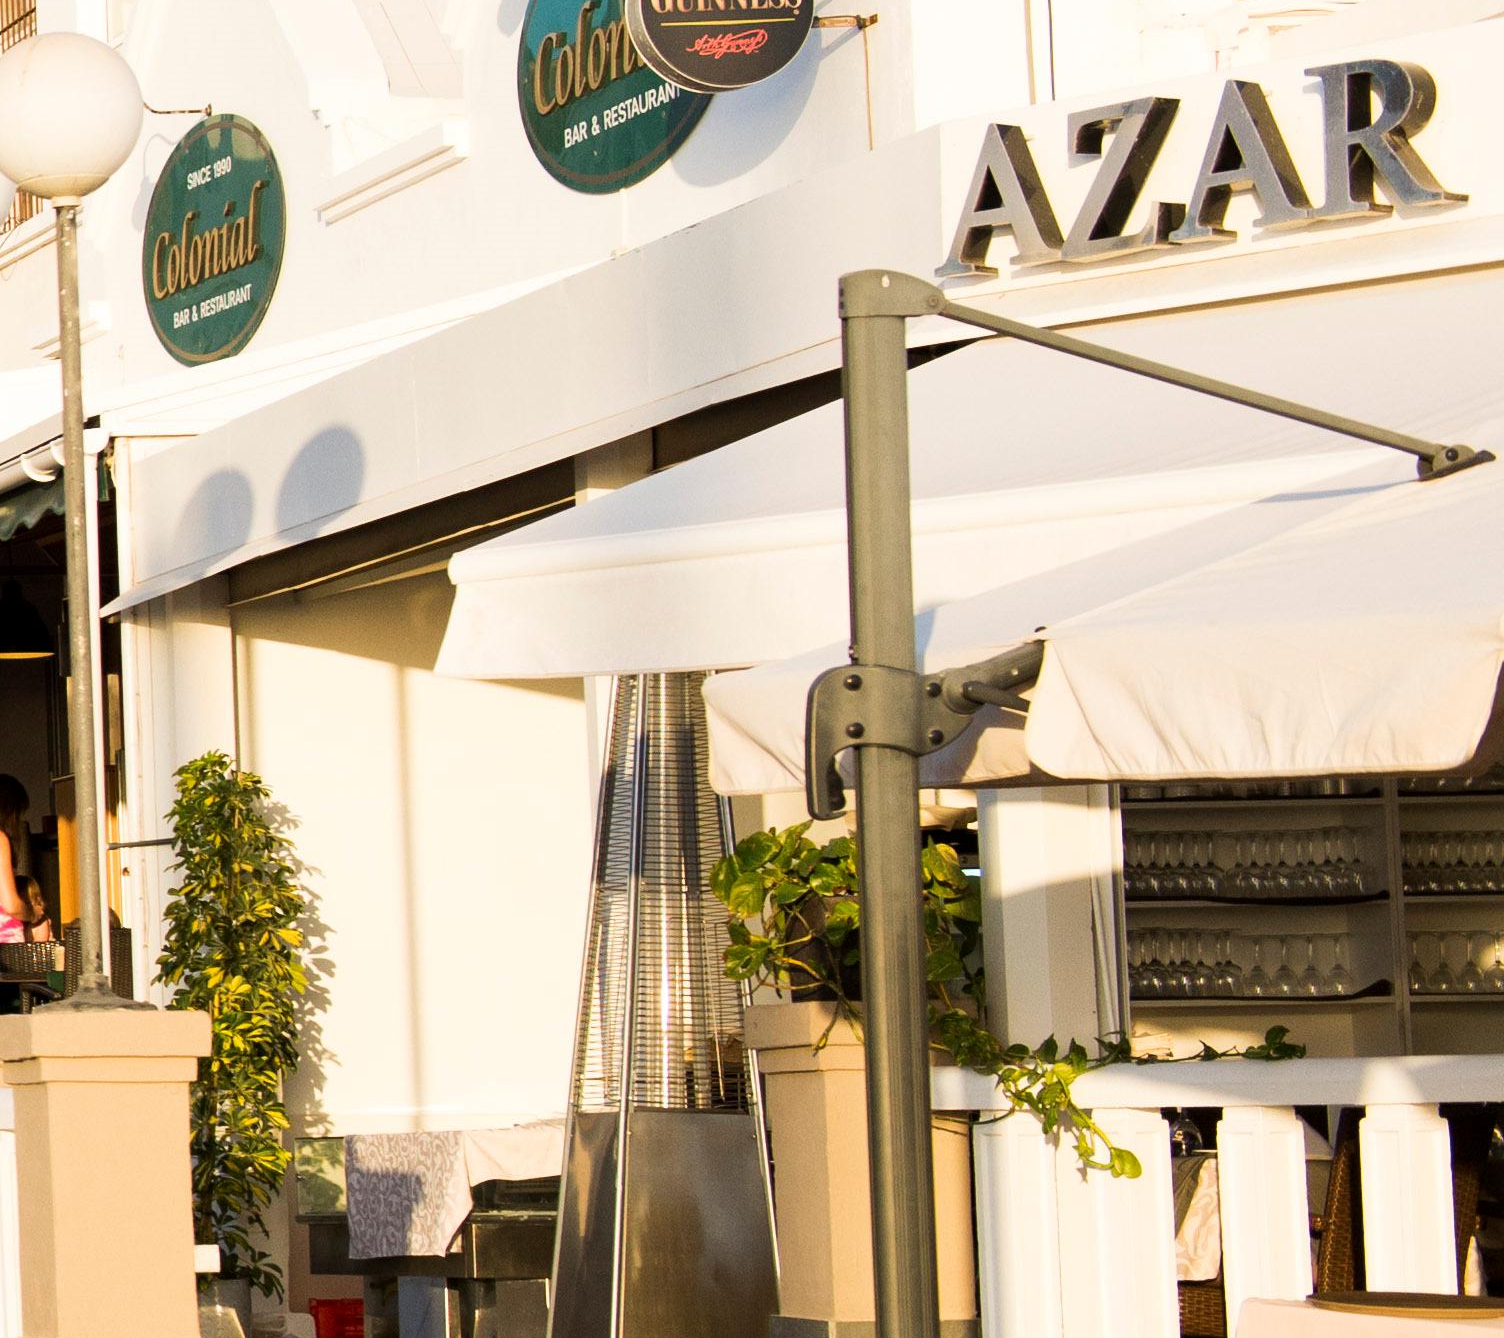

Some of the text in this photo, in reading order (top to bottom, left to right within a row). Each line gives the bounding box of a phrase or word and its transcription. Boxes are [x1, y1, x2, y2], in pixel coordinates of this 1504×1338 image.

[533, 0, 645, 116] Colon
[563, 82, 681, 149] BAR & RESTAURANT
[187, 155, 232, 190] SINCE 1990
[933, 58, 1470, 279] AZAR
[152, 180, 268, 300] Colonial
[173, 283, 252, 329] BAR & RESTAURANT
